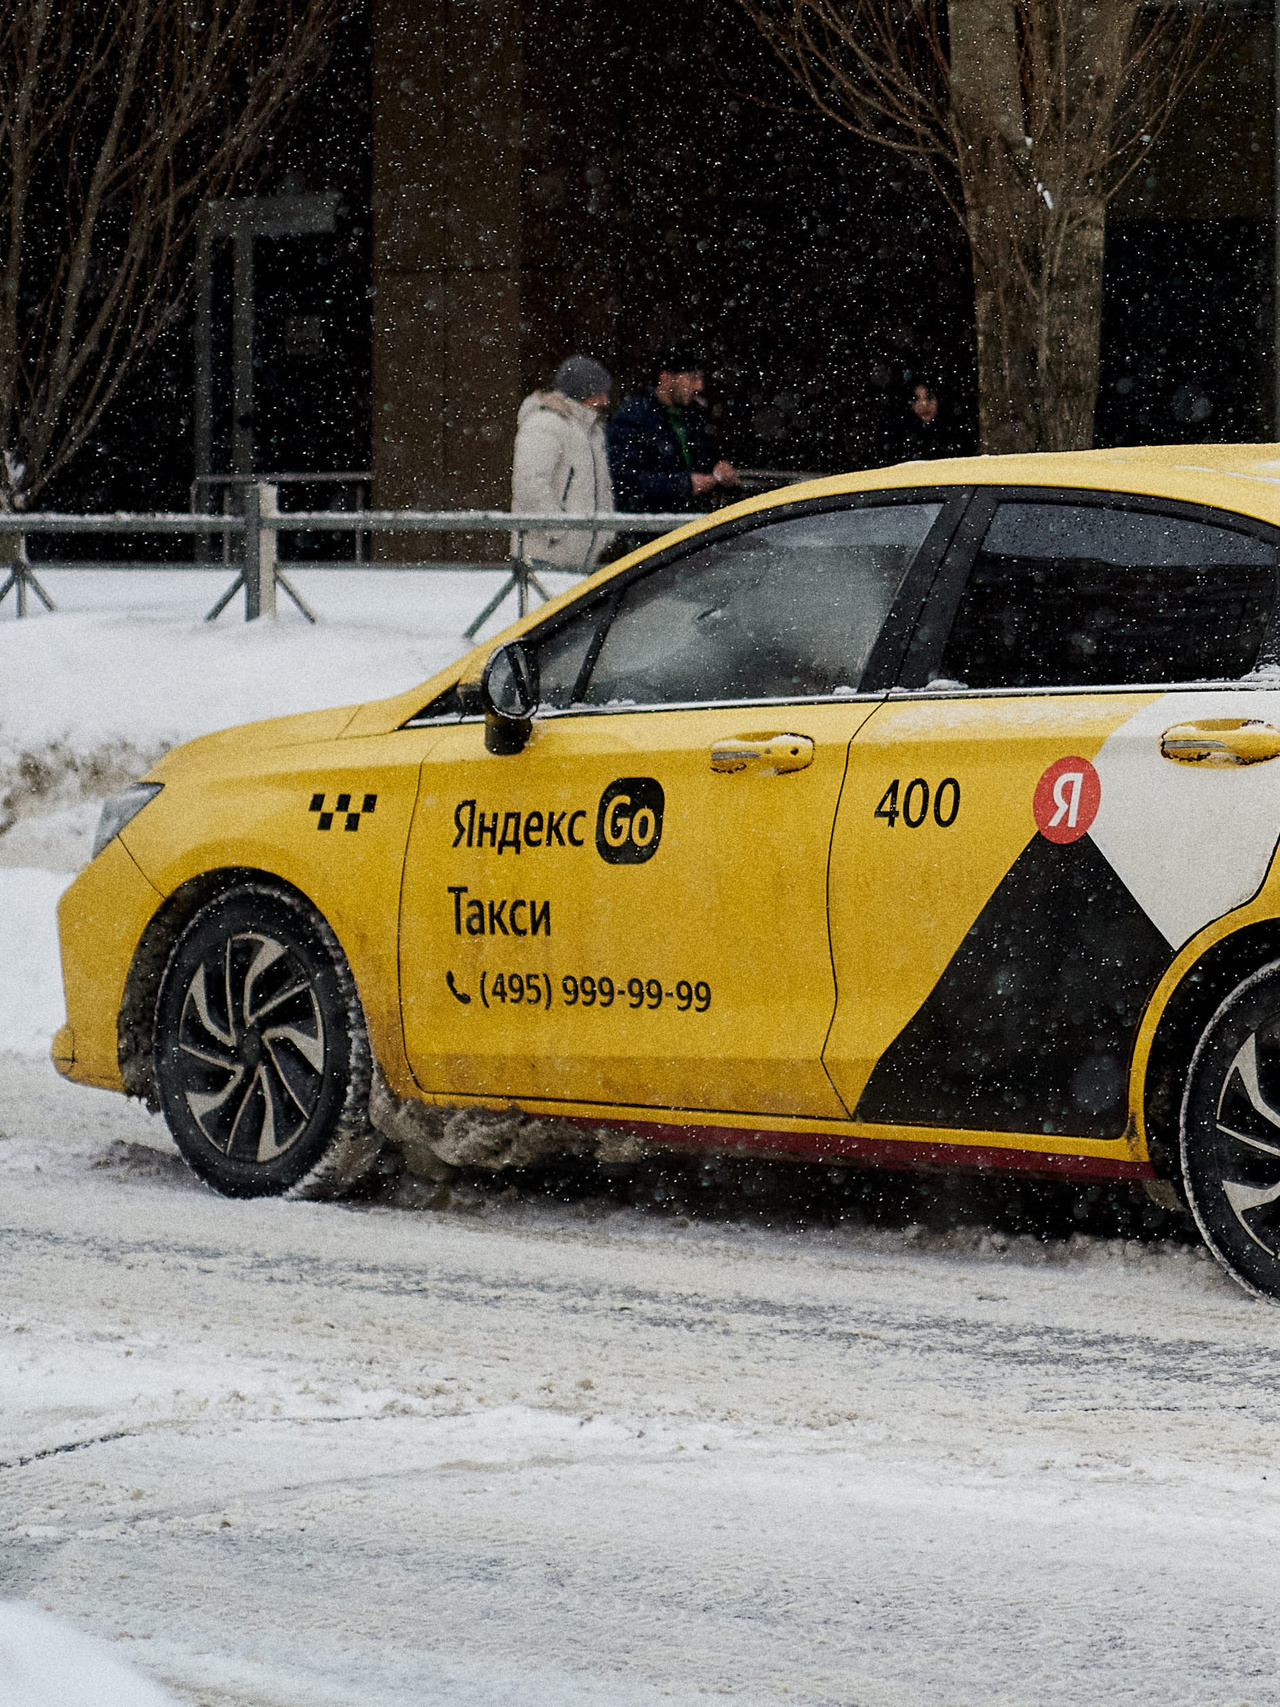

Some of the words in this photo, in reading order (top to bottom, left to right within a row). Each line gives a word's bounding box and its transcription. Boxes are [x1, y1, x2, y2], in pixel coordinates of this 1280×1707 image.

[451, 799, 587, 856] Яндекс
[603, 794, 656, 848] Go
[874, 777, 961, 829] 400
[1047, 771, 1084, 828] Я
[447, 885, 551, 937] Такси
[479, 970, 553, 1010] (495)
[562, 974, 712, 1013] 999-99-99
